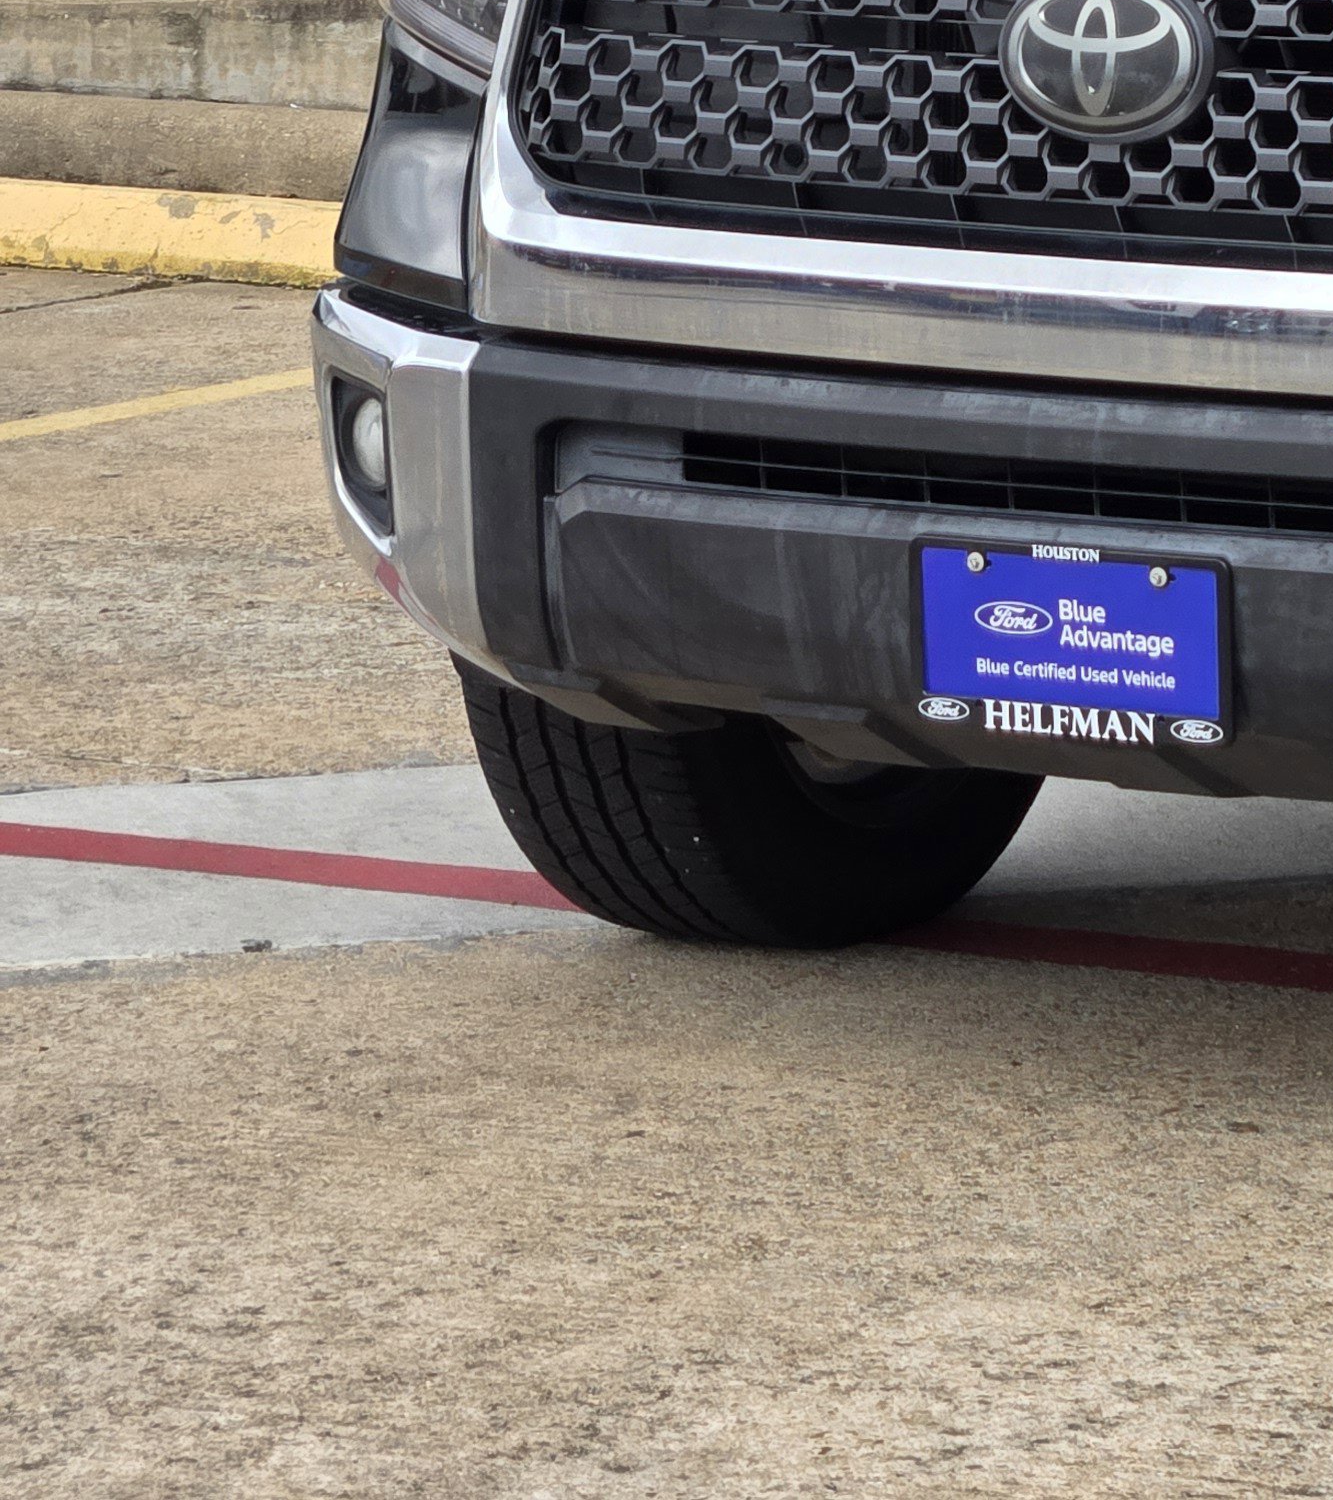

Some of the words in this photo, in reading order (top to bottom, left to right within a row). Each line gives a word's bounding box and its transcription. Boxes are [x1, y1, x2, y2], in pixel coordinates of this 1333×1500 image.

[1032, 544, 1100, 563] HOUSTON
[989, 605, 1037, 630] Ford
[1058, 599, 1106, 624] Blue
[1060, 625, 1175, 657] Advantage
[977, 658, 1010, 676] Blue
[1013, 661, 1077, 682] Certified
[1081, 667, 1118, 684] Used
[1123, 670, 1176, 690] Vehicle
[983, 699, 1156, 746] HELFMAN
